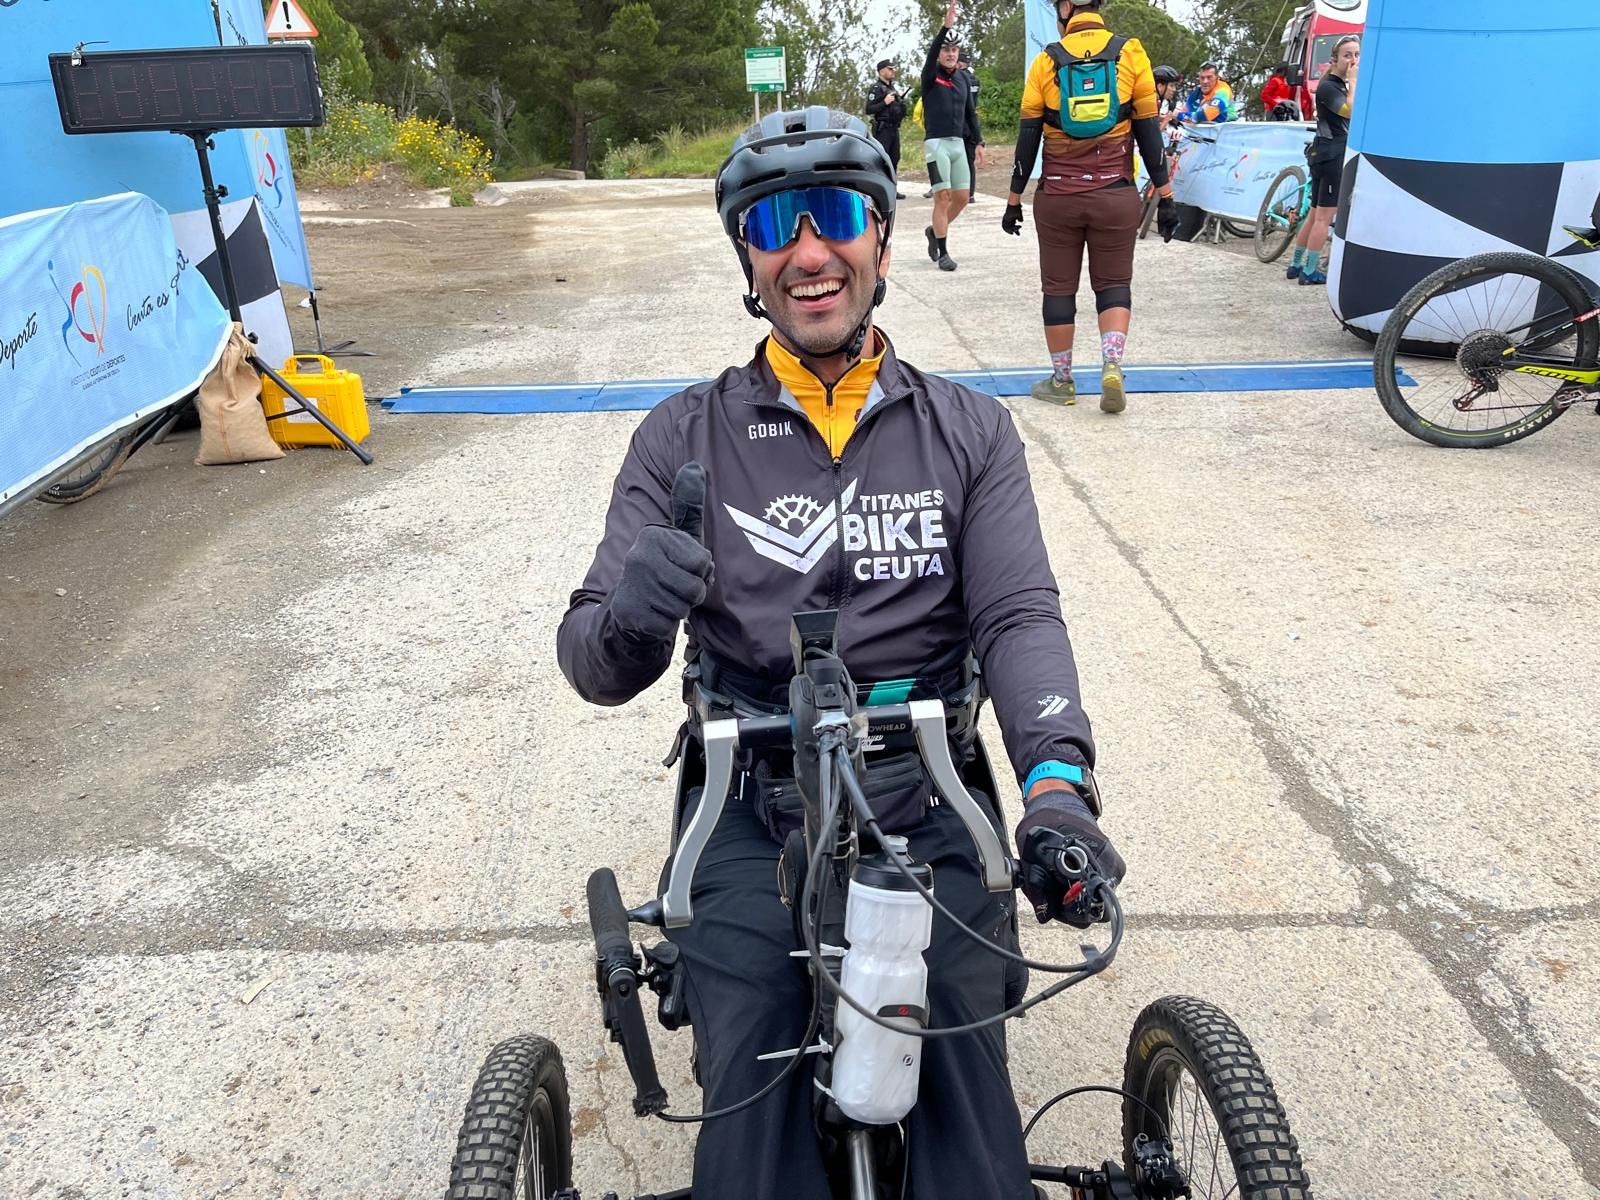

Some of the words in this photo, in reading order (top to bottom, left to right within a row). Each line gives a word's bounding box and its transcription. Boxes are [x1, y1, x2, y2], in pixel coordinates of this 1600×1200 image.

[1524, 367, 1585, 382] SCOTT
[748, 421, 794, 440] GOBIK
[1503, 409, 1553, 438] MAXXIS
[859, 489, 944, 512] TITANES
[842, 510, 948, 552] BIKE
[854, 553, 945, 581] CEUTA
[868, 723, 907, 733] OWHEAD
